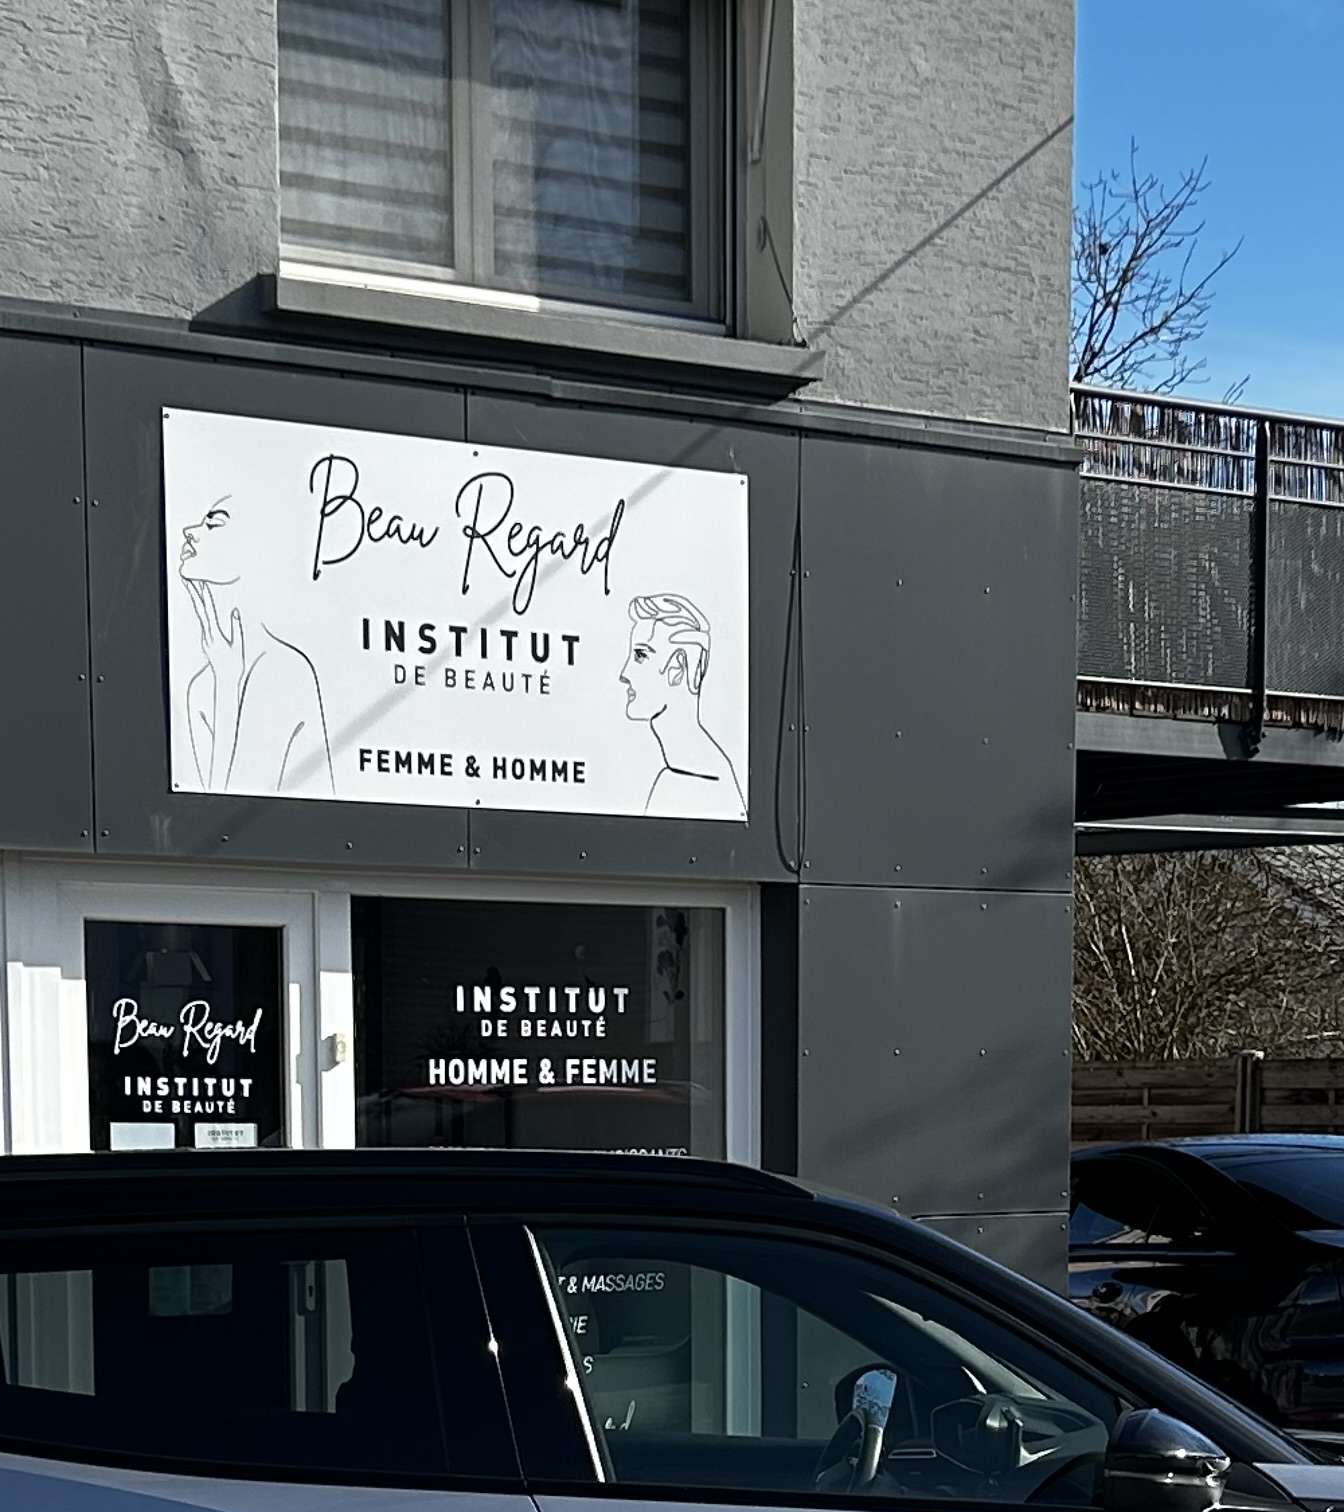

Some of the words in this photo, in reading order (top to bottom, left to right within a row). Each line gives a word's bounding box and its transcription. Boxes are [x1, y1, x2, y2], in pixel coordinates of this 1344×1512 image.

[309, 454, 440, 580] Beau
[456, 472, 625, 615] Regard
[362, 618, 580, 666] INSTITUT
[394, 665, 426, 687] DE
[444, 668, 551, 695] BEAUTÉ
[359, 748, 453, 777] FEMME
[464, 755, 481, 778] &
[493, 757, 586, 784] HOMME
[456, 985, 629, 1013] INSTITUT
[112, 998, 175, 1055] Beau
[180, 1000, 263, 1065] Regard
[481, 1019, 507, 1037] DE
[520, 1016, 606, 1037] BEAUTÉ
[428, 1058, 528, 1085] HOMME
[538, 1058, 555, 1084] &
[565, 1058, 656, 1084] FEMME
[124, 1076, 252, 1097] INSTITUT
[142, 1100, 163, 1113] DE
[172, 1098, 236, 1114] BEAUTÉ
[567, 1276, 577, 1293] &
[581, 1272, 665, 1293] MASSAGES
